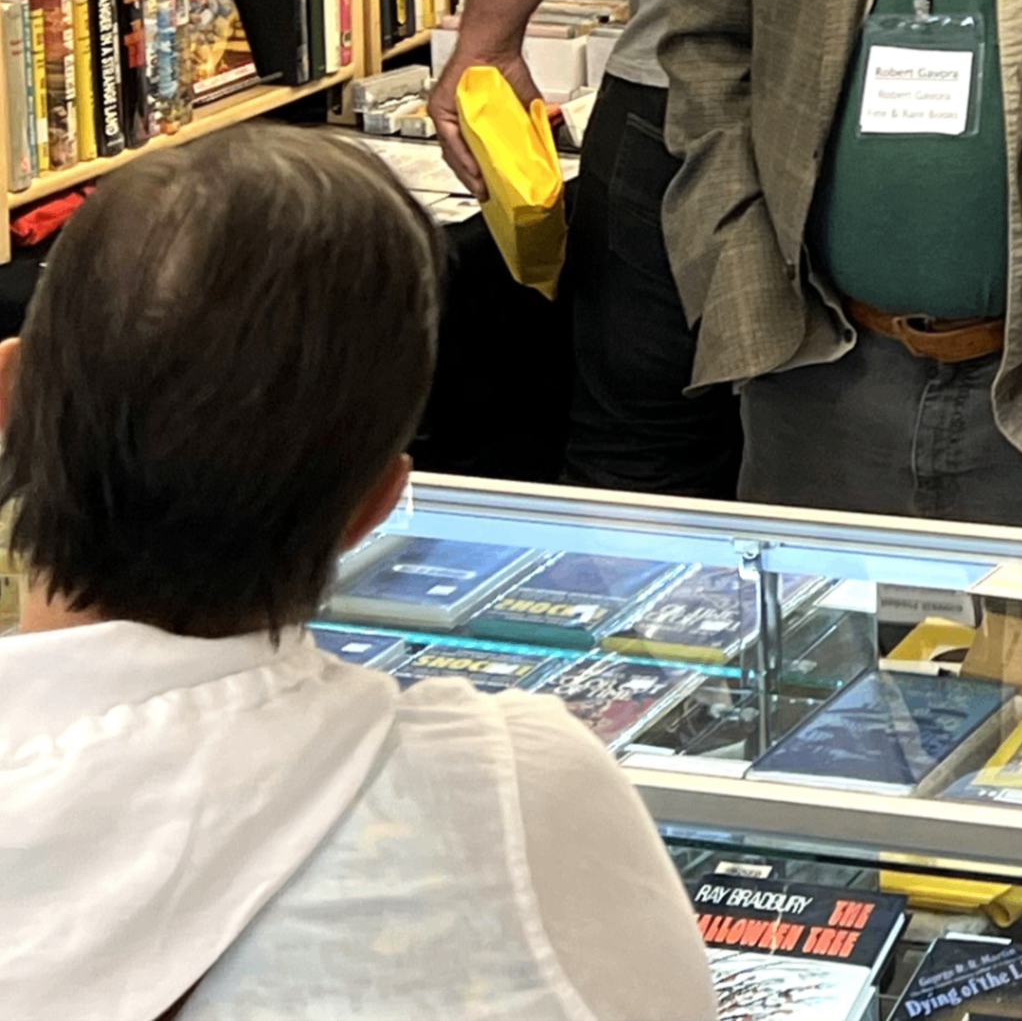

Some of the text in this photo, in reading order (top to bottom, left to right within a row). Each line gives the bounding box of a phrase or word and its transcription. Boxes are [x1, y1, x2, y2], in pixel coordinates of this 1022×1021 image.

[100, 34, 113, 47] IN
[102, 48, 114, 58] A
[102, 58, 117, 105] STRANGE
[875, 66, 959, 79] Robert Gavora
[878, 89, 912, 99] Robert
[105, 106, 119, 136] LAND
[493, 598, 596, 619] SHOC
[412, 655, 514, 674] SHOC
[695, 884, 813, 914] RAY BRADBURY
[828, 899, 876, 929] THE
[697, 913, 861, 958] ALLOWEEN TREE
[918, 969, 954, 988] George
[980, 948, 1017, 965] Martin
[904, 989, 963, 1018] Dying
[961, 980, 979, 998] of
[977, 972, 1010, 992] the
